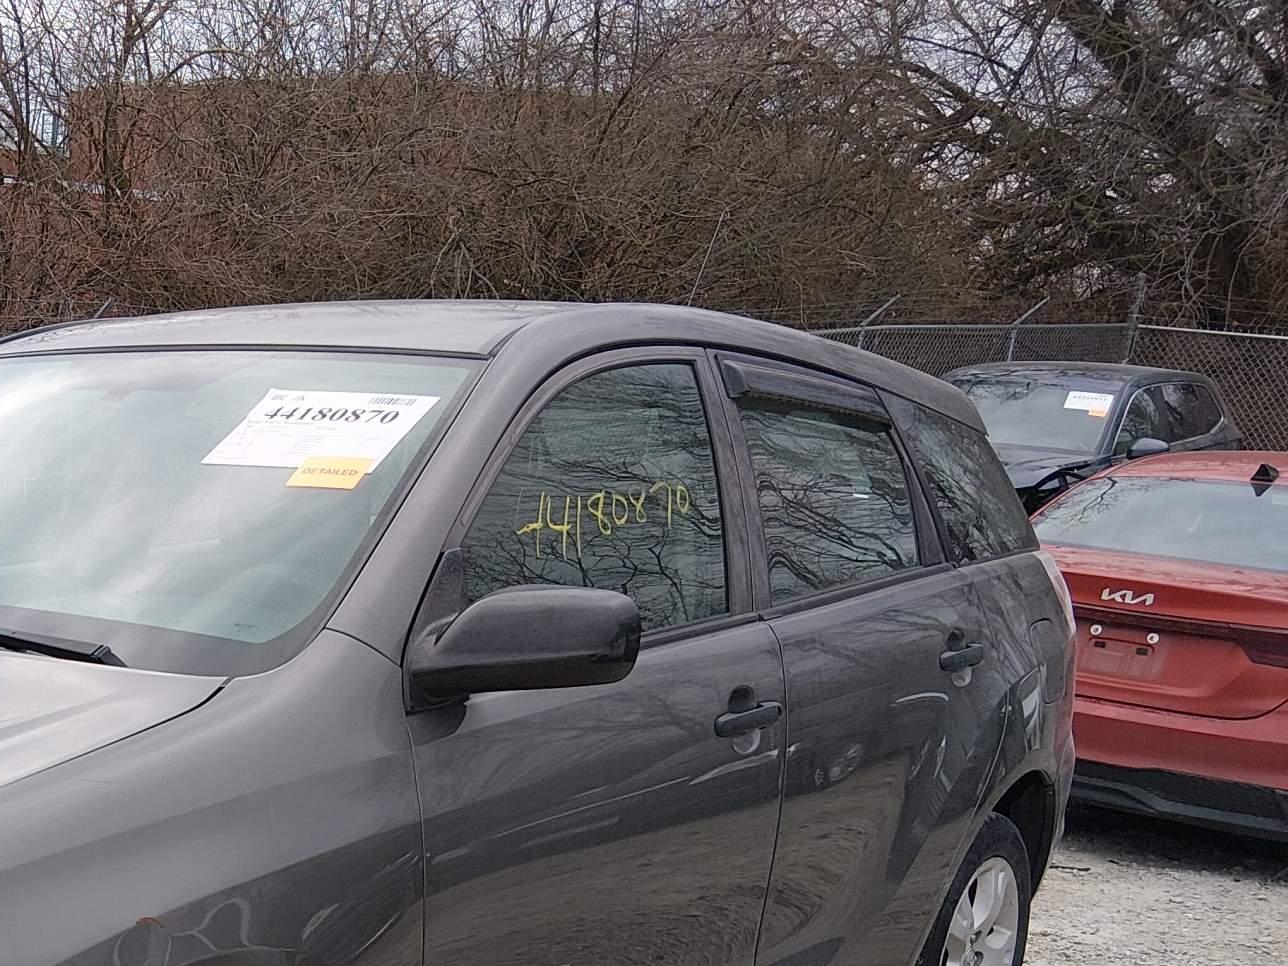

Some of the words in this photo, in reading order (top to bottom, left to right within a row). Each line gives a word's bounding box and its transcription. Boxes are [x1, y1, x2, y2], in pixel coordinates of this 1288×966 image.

[264, 406, 400, 425] 44180870
[301, 467, 359, 478] DETAILED
[515, 480, 690, 560] 44180870
